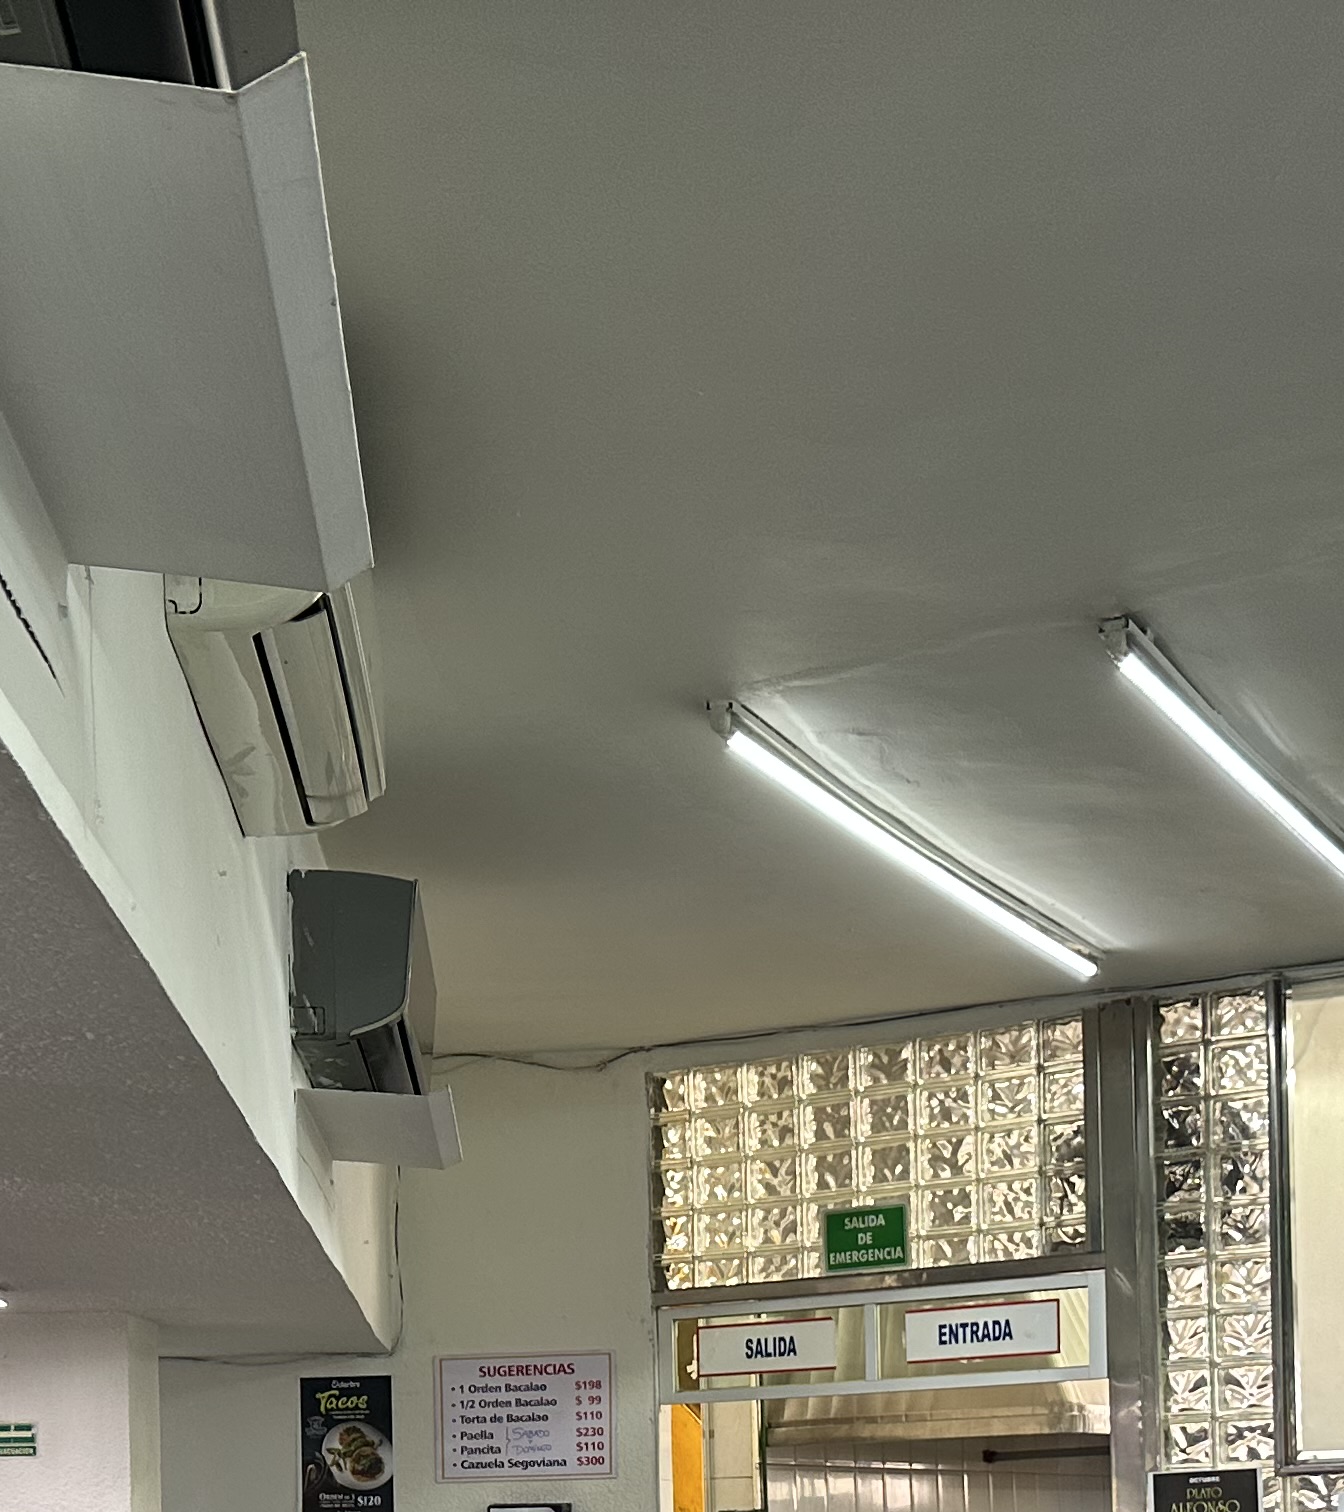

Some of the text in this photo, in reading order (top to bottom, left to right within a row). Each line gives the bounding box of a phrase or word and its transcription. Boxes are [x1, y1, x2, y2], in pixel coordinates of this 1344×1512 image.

[844, 1213, 886, 1230] SALIDA
[857, 1232, 874, 1245] DE
[829, 1246, 904, 1265] EMERGENCIA
[937, 1318, 1014, 1346] ENTRADA
[744, 1335, 798, 1360] SALIDA
[478, 1362, 576, 1378] SUGERENCIAS
[459, 1382, 548, 1394] 1 Orden Bacalao
[574, 1379, 602, 1391] $198
[315, 1389, 369, 1415] Tacos
[459, 1396, 558, 1411] 1/2 Orden Bacalao
[459, 1412, 549, 1425] Torta de Bacalao
[575, 1410, 603, 1422] $110
[460, 1429, 494, 1441] Paella
[576, 1425, 604, 1437] $230
[460, 1445, 502, 1456] Pancita
[576, 1441, 604, 1452] $110
[460, 1457, 567, 1471] Cazuela Segoviana
[576, 1455, 605, 1467] $300
[1186, 1486, 1223, 1499] PLATO
[356, 1495, 382, 1506] $120
